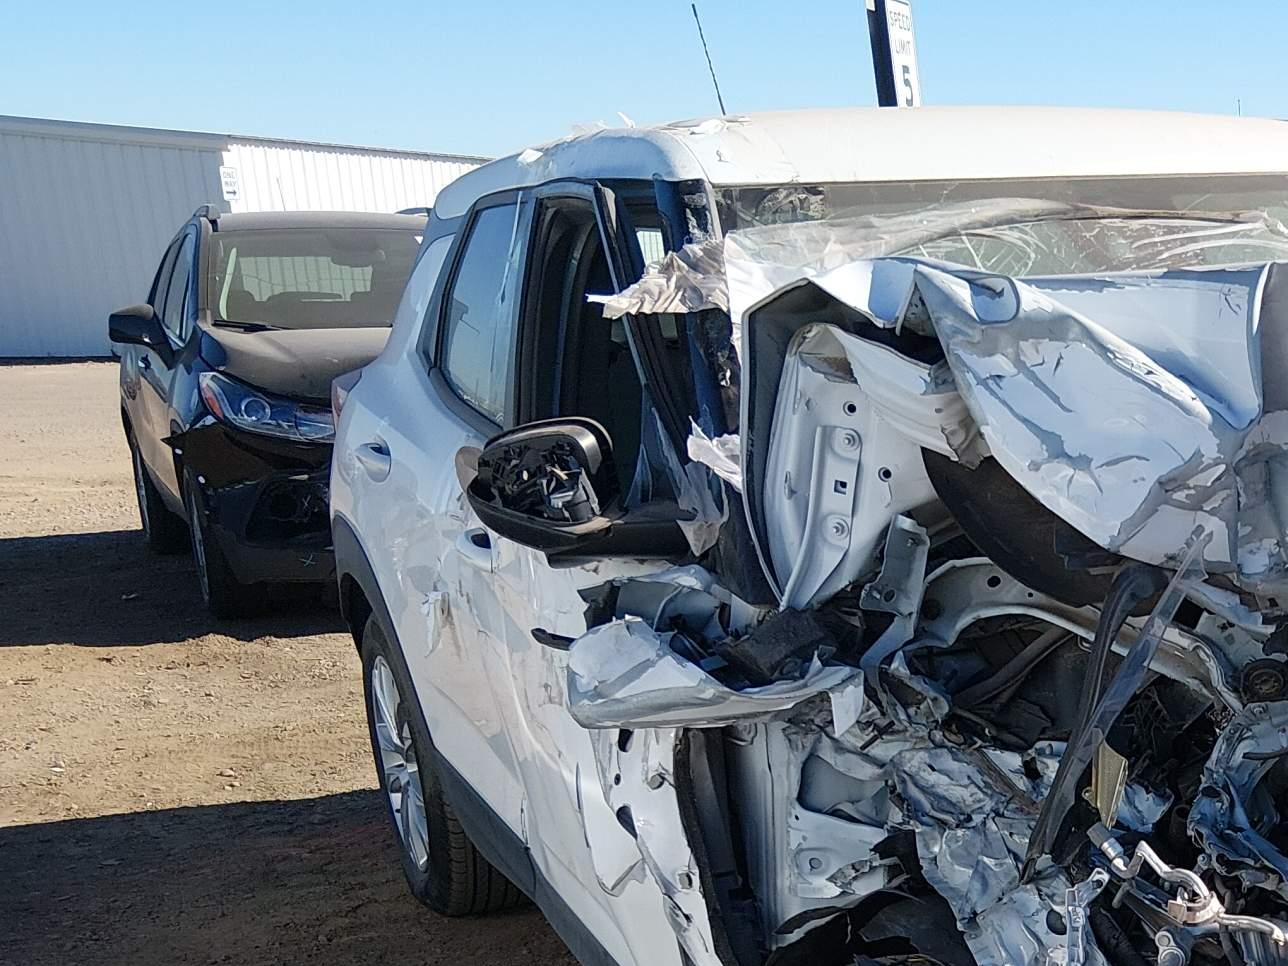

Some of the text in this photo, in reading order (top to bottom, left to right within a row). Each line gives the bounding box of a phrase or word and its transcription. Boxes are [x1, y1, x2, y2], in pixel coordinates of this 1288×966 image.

[889, 10, 911, 32] SPEED
[894, 38, 911, 56] LIMIT
[902, 64, 914, 107] 5
